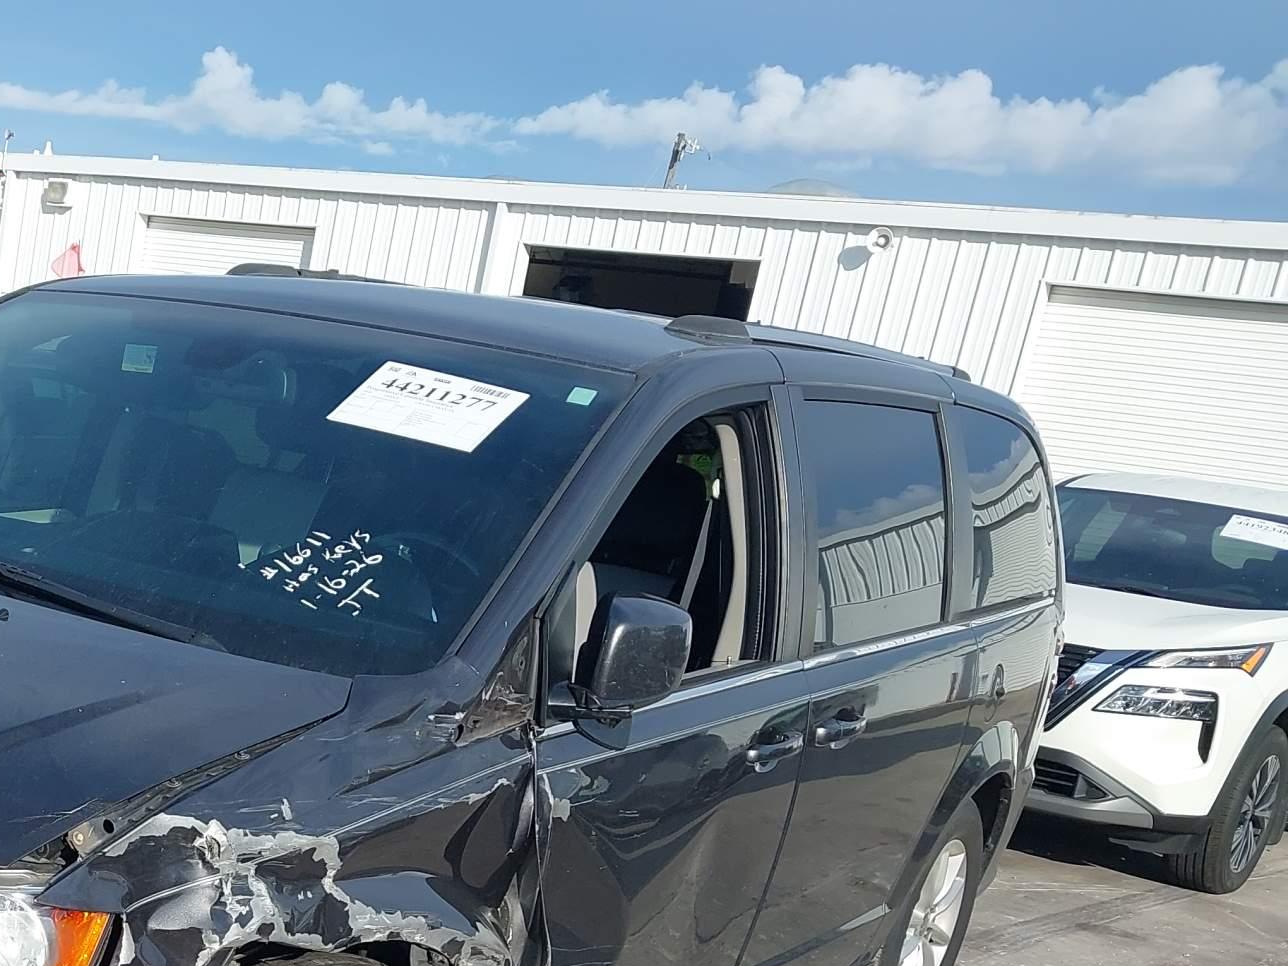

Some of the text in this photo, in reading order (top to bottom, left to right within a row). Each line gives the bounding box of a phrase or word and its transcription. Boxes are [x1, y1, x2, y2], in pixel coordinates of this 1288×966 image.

[381, 377, 498, 412] 44211277
[260, 531, 332, 580] #16611
[300, 552, 384, 610] 1-16-26
